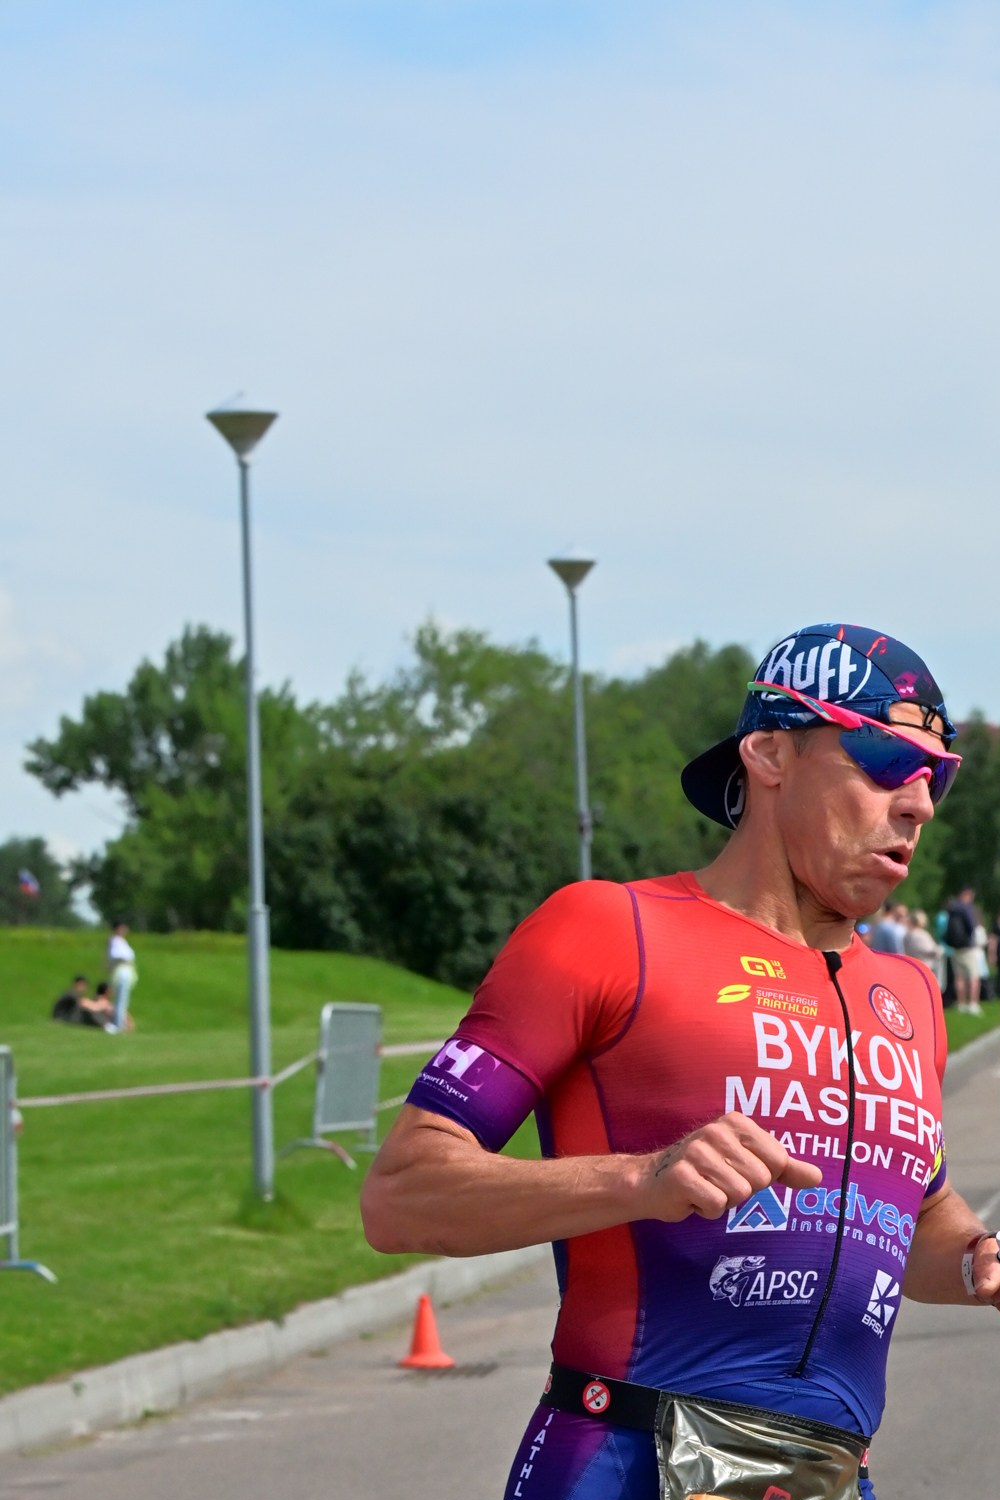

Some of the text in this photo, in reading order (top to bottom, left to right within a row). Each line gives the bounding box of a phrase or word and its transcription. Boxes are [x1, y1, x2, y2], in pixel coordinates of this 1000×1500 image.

[755, 996, 818, 1017] TRIATHLON
[756, 989, 818, 1007] SUPER LEAGUE
[752, 1012, 923, 1100] BYKOV
[770, 1130, 931, 1190] ATHLON TEA
[745, 1271, 818, 1301] APSC
[861, 1313, 885, 1339] BASK
